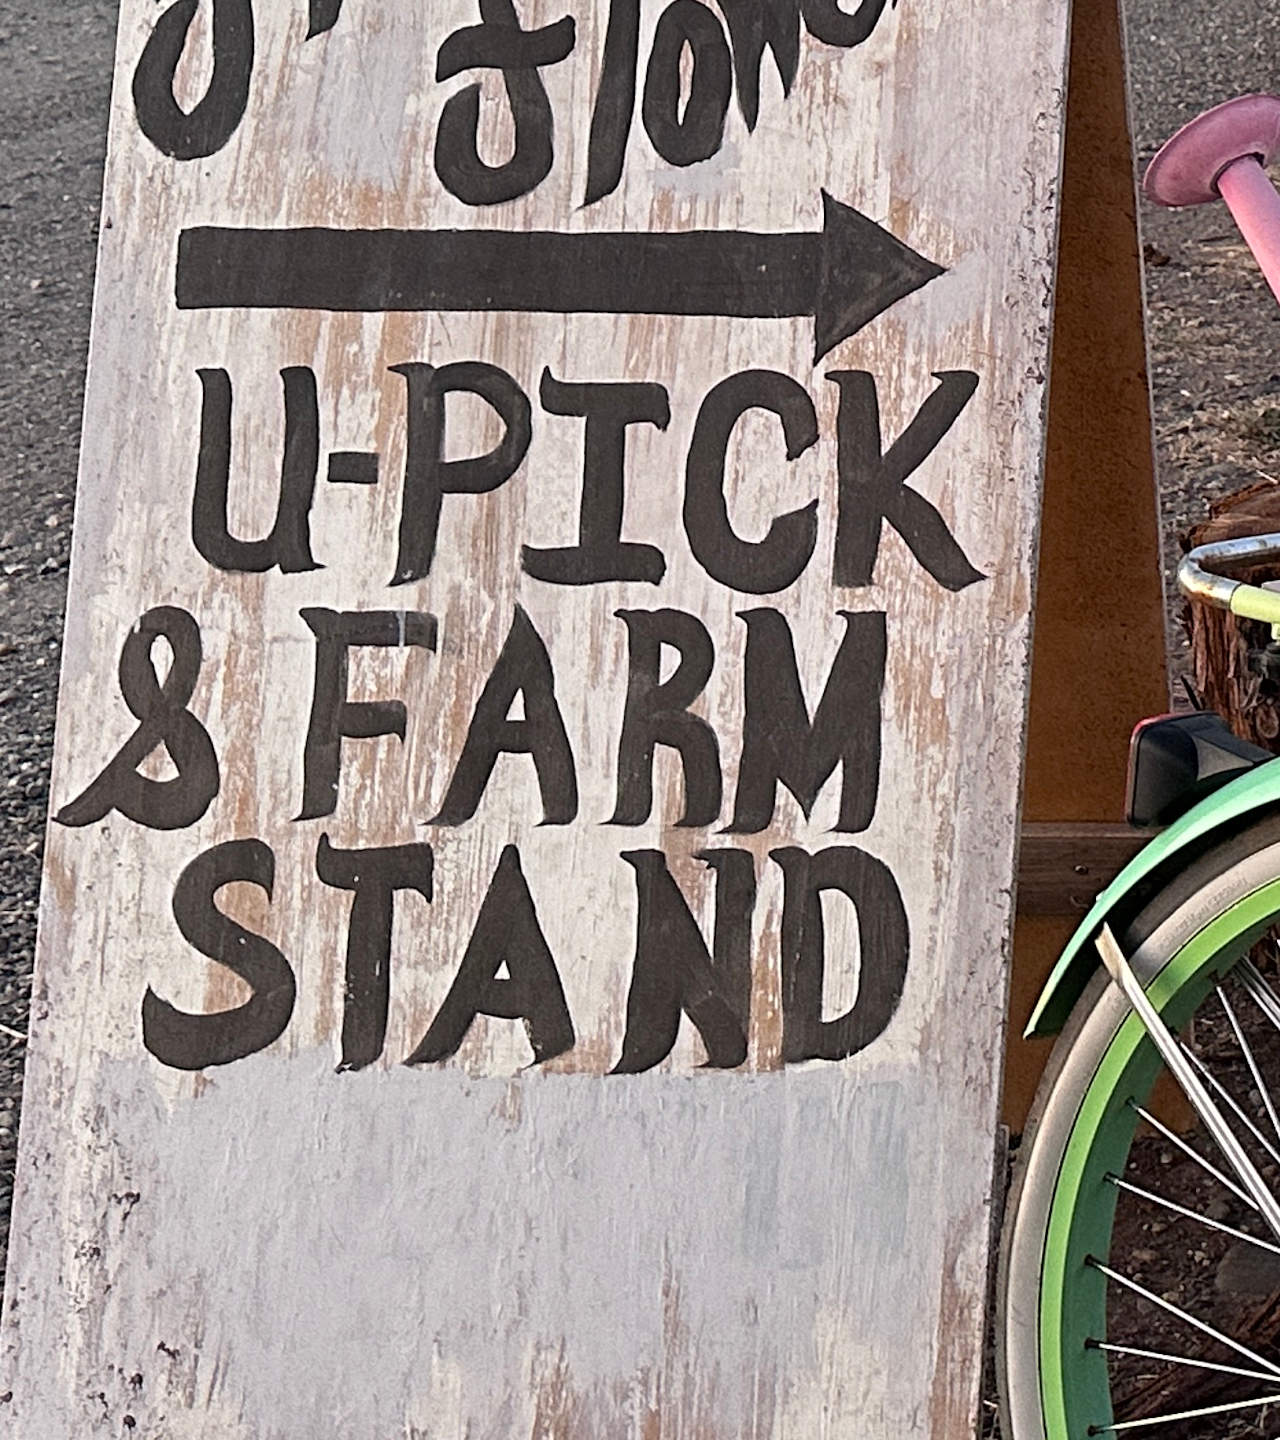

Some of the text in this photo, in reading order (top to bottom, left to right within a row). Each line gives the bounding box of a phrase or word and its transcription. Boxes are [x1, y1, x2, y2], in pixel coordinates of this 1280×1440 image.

[191, 360, 988, 594] U-PICK
[52, 603, 888, 835] & FARM
[141, 832, 910, 1075] STAND
